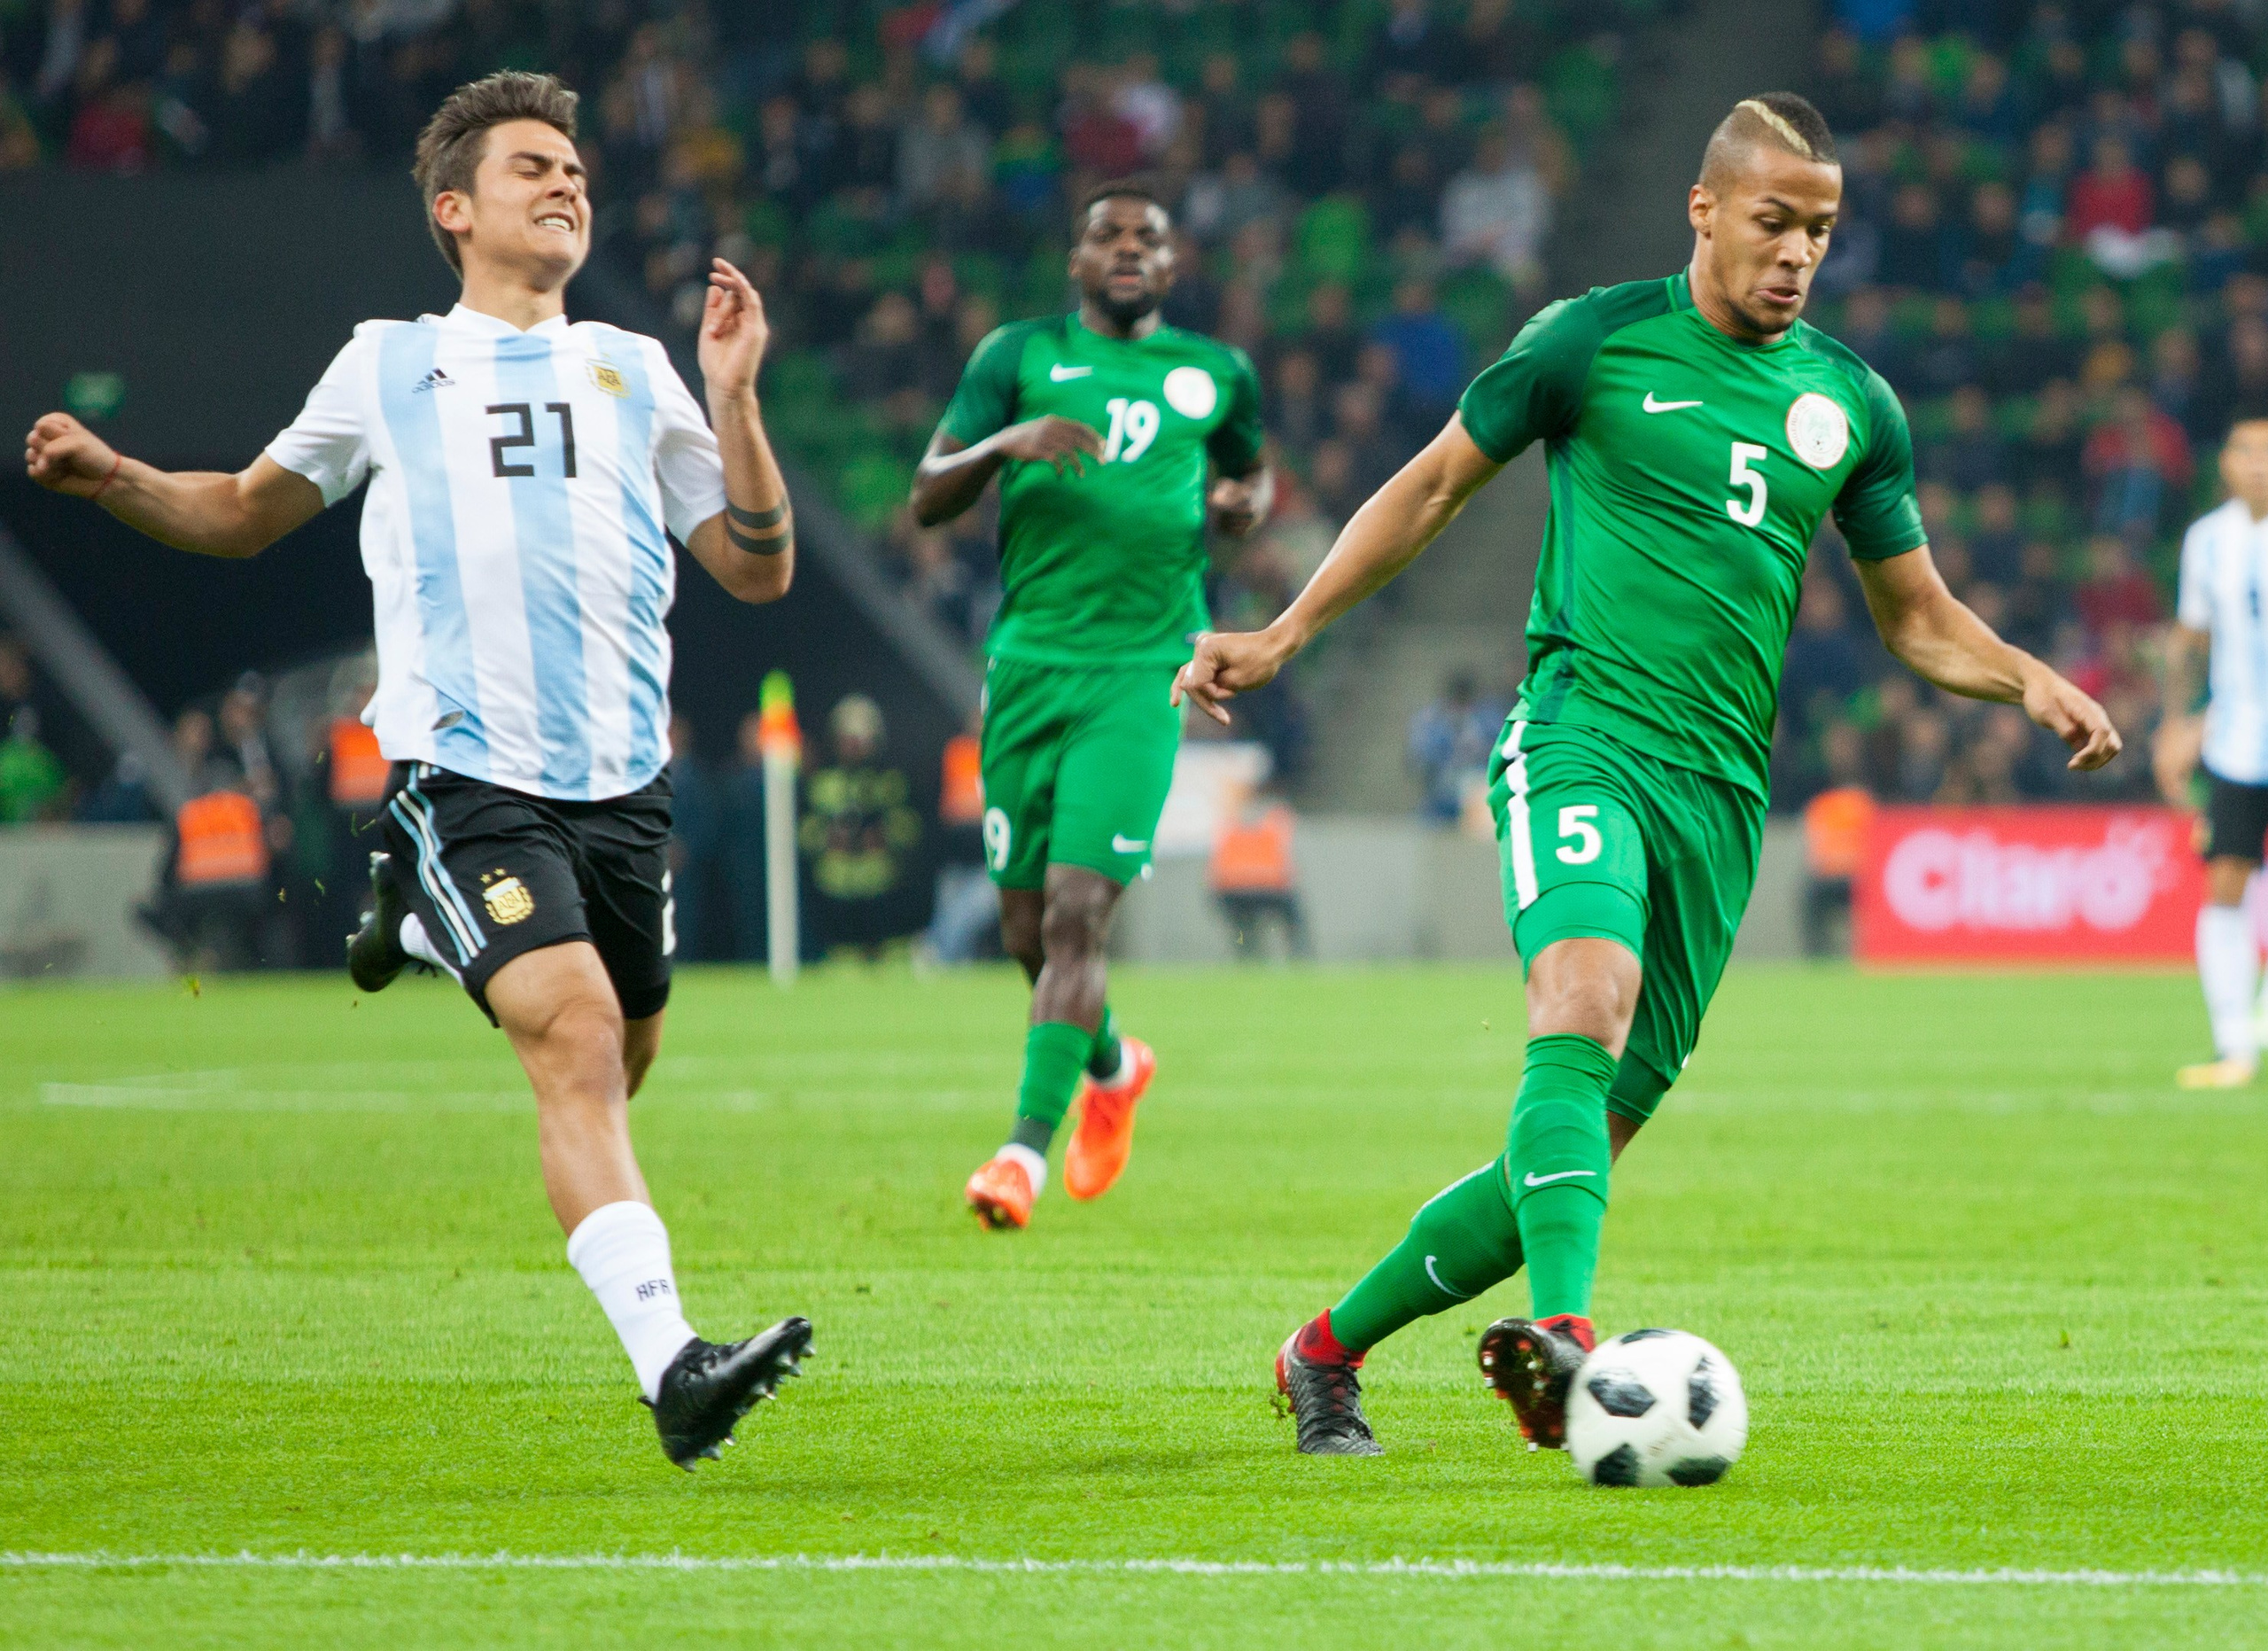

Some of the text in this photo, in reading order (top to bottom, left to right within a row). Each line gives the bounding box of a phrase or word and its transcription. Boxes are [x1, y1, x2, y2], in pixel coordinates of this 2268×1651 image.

[484, 402, 577, 478] 21
[1105, 397, 1161, 463] 19
[1725, 441, 1767, 526] 5
[983, 806, 1011, 871] 9
[1555, 804, 1603, 863] 5
